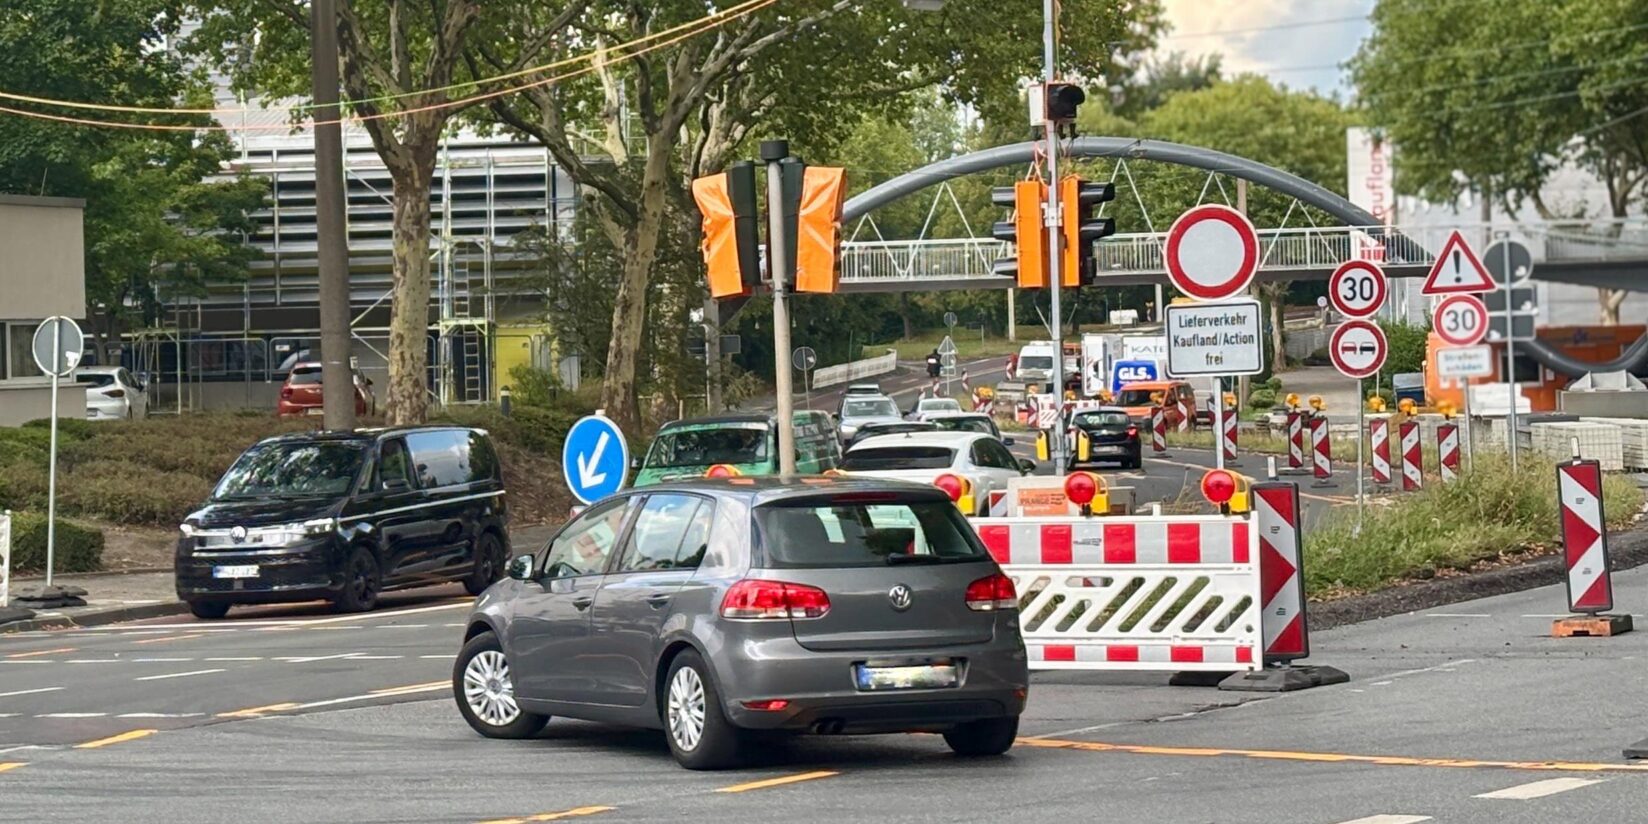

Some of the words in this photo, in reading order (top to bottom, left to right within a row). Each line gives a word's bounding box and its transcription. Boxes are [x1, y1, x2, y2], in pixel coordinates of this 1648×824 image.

[1343, 276, 1374, 301] 30
[1178, 312, 1247, 328] Lieferverkehr
[1445, 309, 1476, 332] 30
[1173, 331, 1254, 347] Kaufland/Action
[1205, 351, 1224, 365] frei
